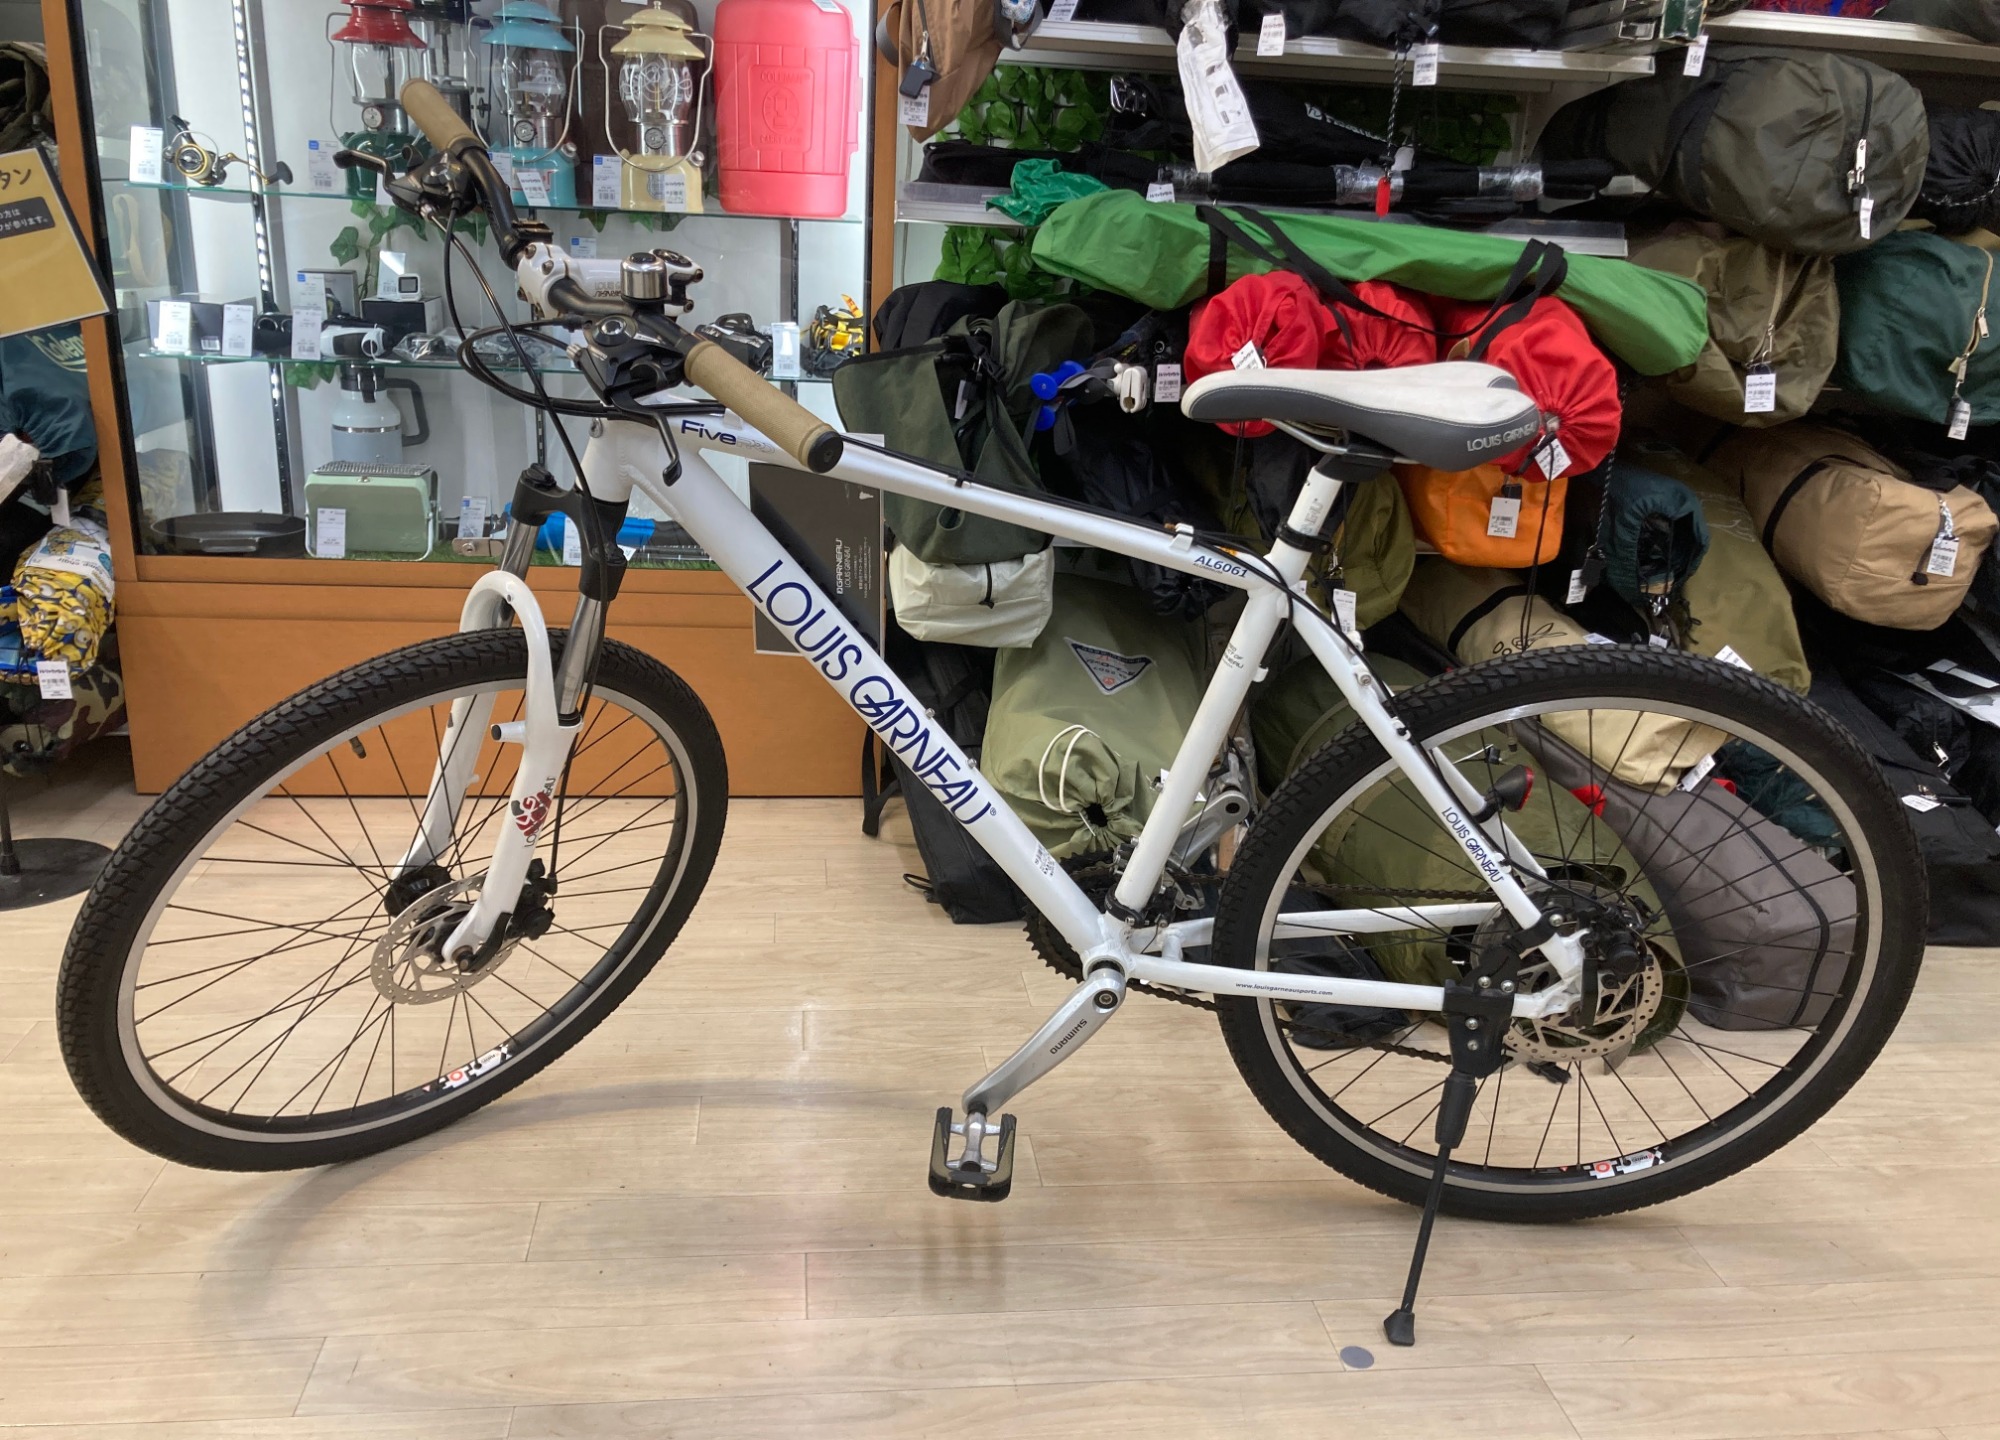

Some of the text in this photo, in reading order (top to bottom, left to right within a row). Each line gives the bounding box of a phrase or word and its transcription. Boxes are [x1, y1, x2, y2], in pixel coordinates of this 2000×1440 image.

[681, 419, 737, 446] Five
[1466, 433, 1502, 452] LOUIS
[1194, 555, 1249, 578] AL6061
[746, 558, 862, 681] LOUIS
[1441, 806, 1504, 883] LOUIS GARNEAU
[1235, 982, 1334, 996] www.louisgarneausports.com
[1049, 1018, 1088, 1055] SHIMANO
